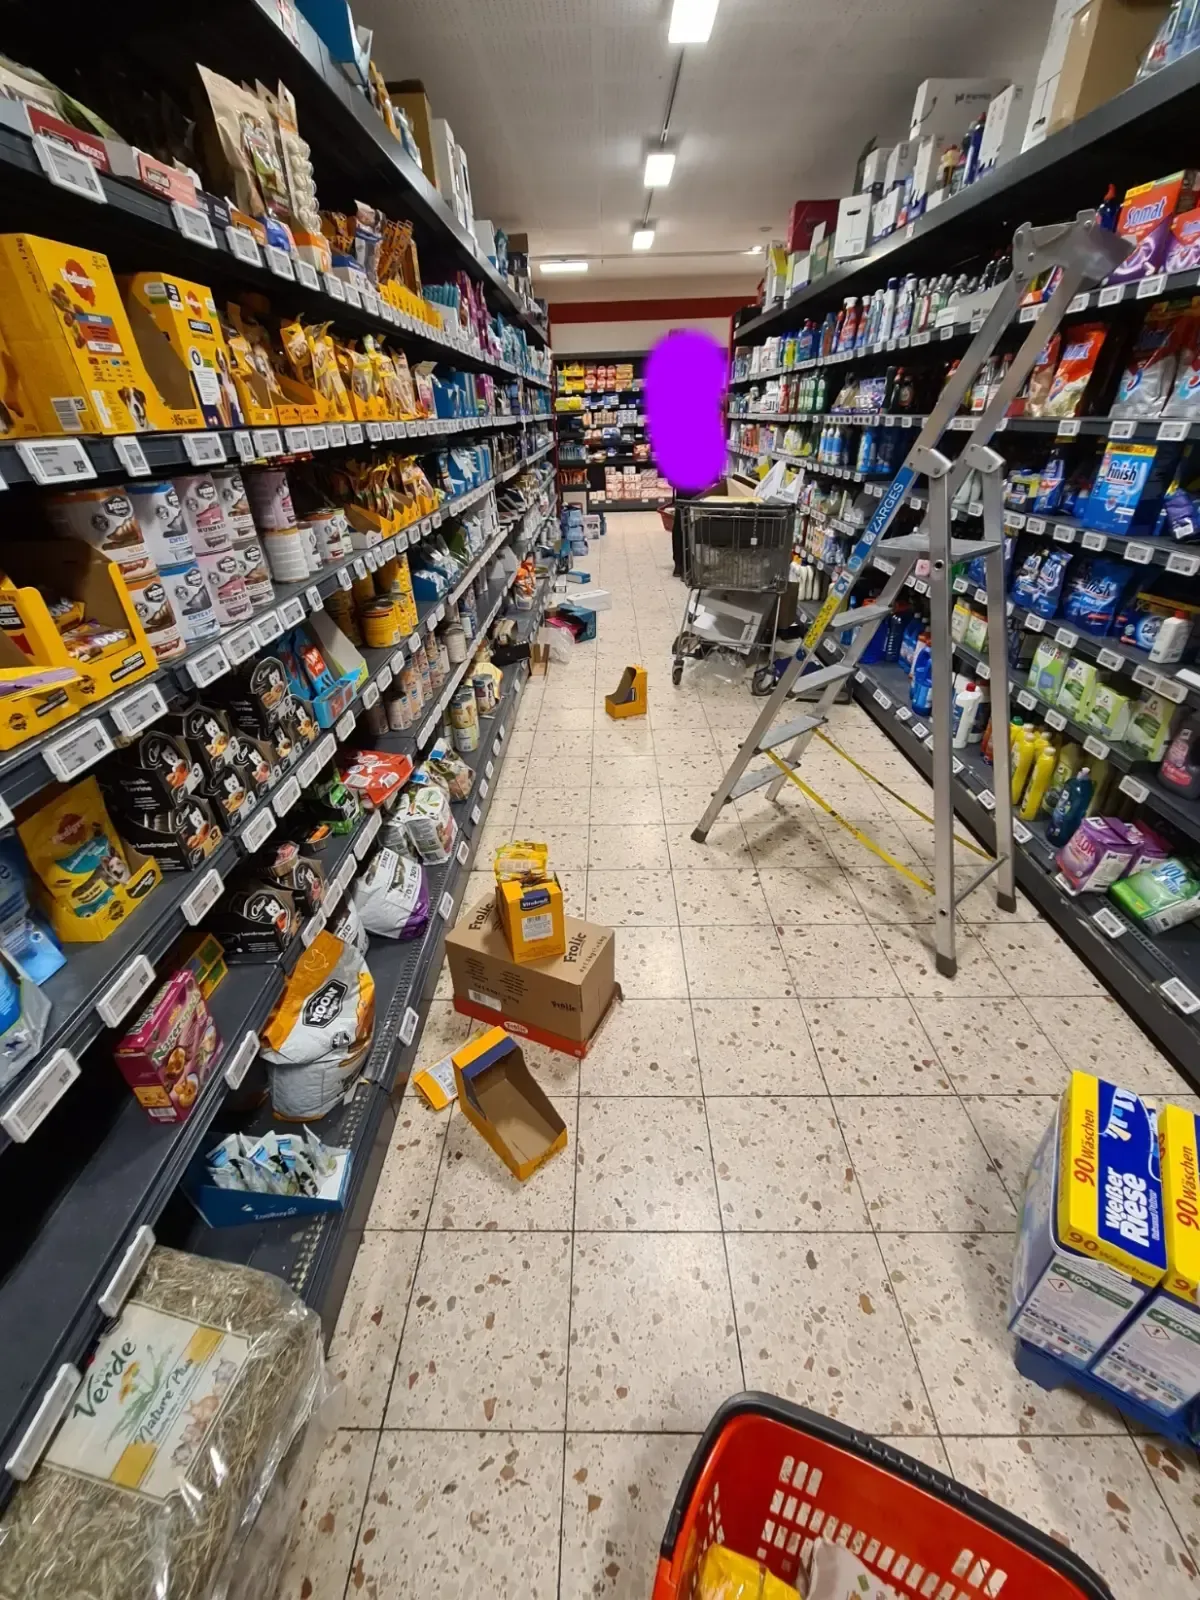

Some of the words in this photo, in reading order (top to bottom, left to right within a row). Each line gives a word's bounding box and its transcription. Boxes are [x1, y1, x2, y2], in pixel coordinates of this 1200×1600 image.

[1125, 196, 1167, 228] Somat
[1107, 460, 1137, 481] finish
[872, 482, 904, 533] ZARGES
[468, 902, 495, 931] Frolic
[563, 932, 588, 963] Frolic
[309, 986, 339, 1023] MOON
[1080, 1108, 1096, 1160] Wäschen
[1073, 1157, 1096, 1187] 90
[1179, 1145, 1198, 1202] Wäschen
[1104, 1165, 1124, 1229] Weißer
[1119, 1172, 1151, 1248] Riese
[1175, 1198, 1200, 1231] 90
[1067, 1231, 1099, 1252] 90
[73, 1338, 137, 1418] Verde
[133, 1390, 174, 1445] Nature
